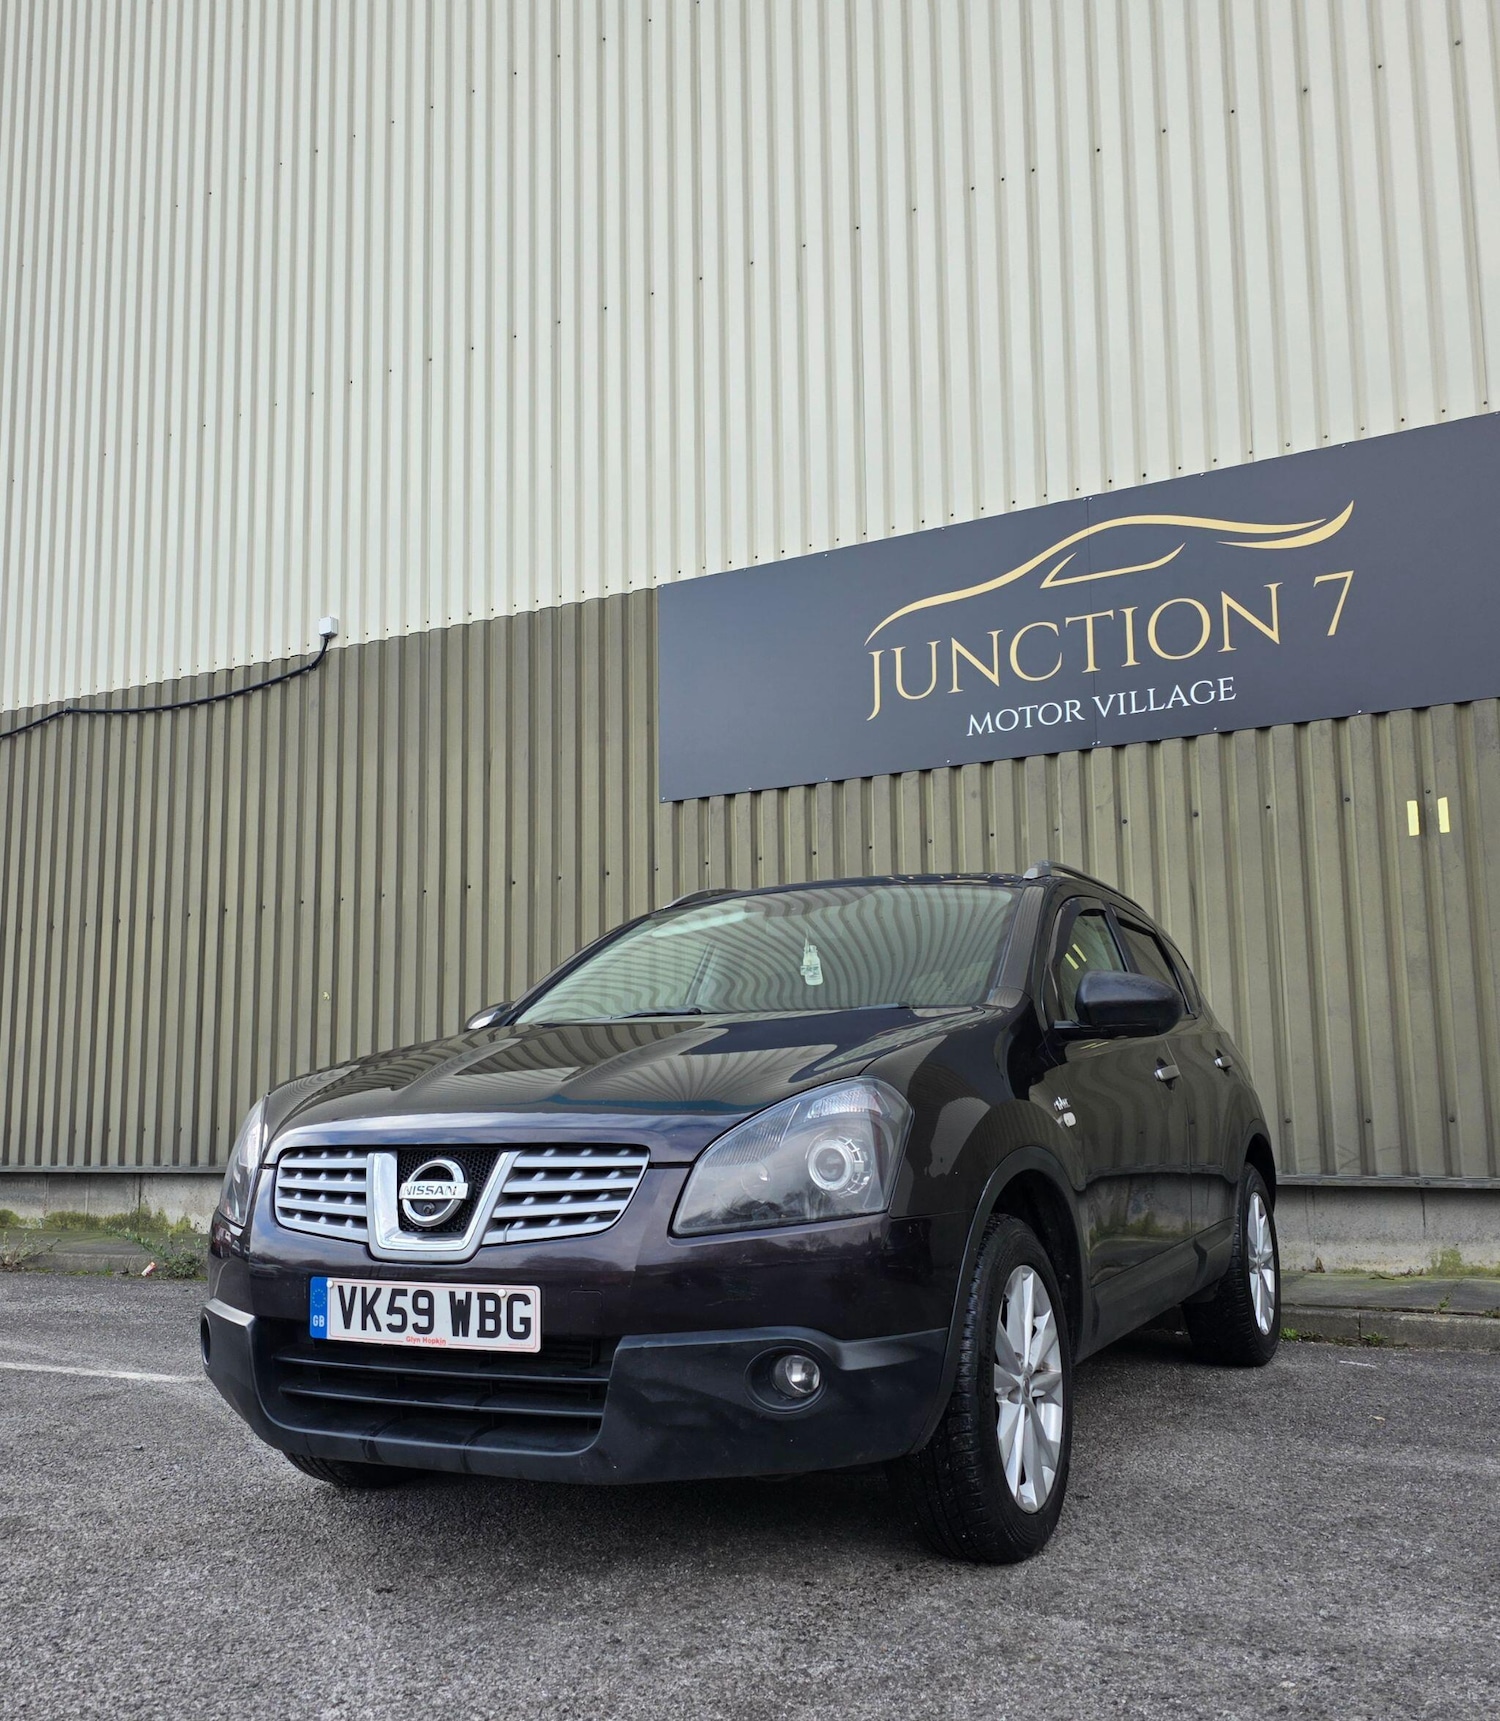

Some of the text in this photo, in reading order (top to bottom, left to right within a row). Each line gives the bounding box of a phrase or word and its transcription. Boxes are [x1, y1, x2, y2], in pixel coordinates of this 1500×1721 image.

[867, 570, 1354, 721] JUNCTION 7
[966, 676, 1237, 737] MOTOR VILLAGE
[402, 1185, 457, 1196] NISSAN
[312, 1314, 325, 1327] GB
[338, 1285, 532, 1340] VK59 WBG
[405, 1335, 420, 1344] Glyn
